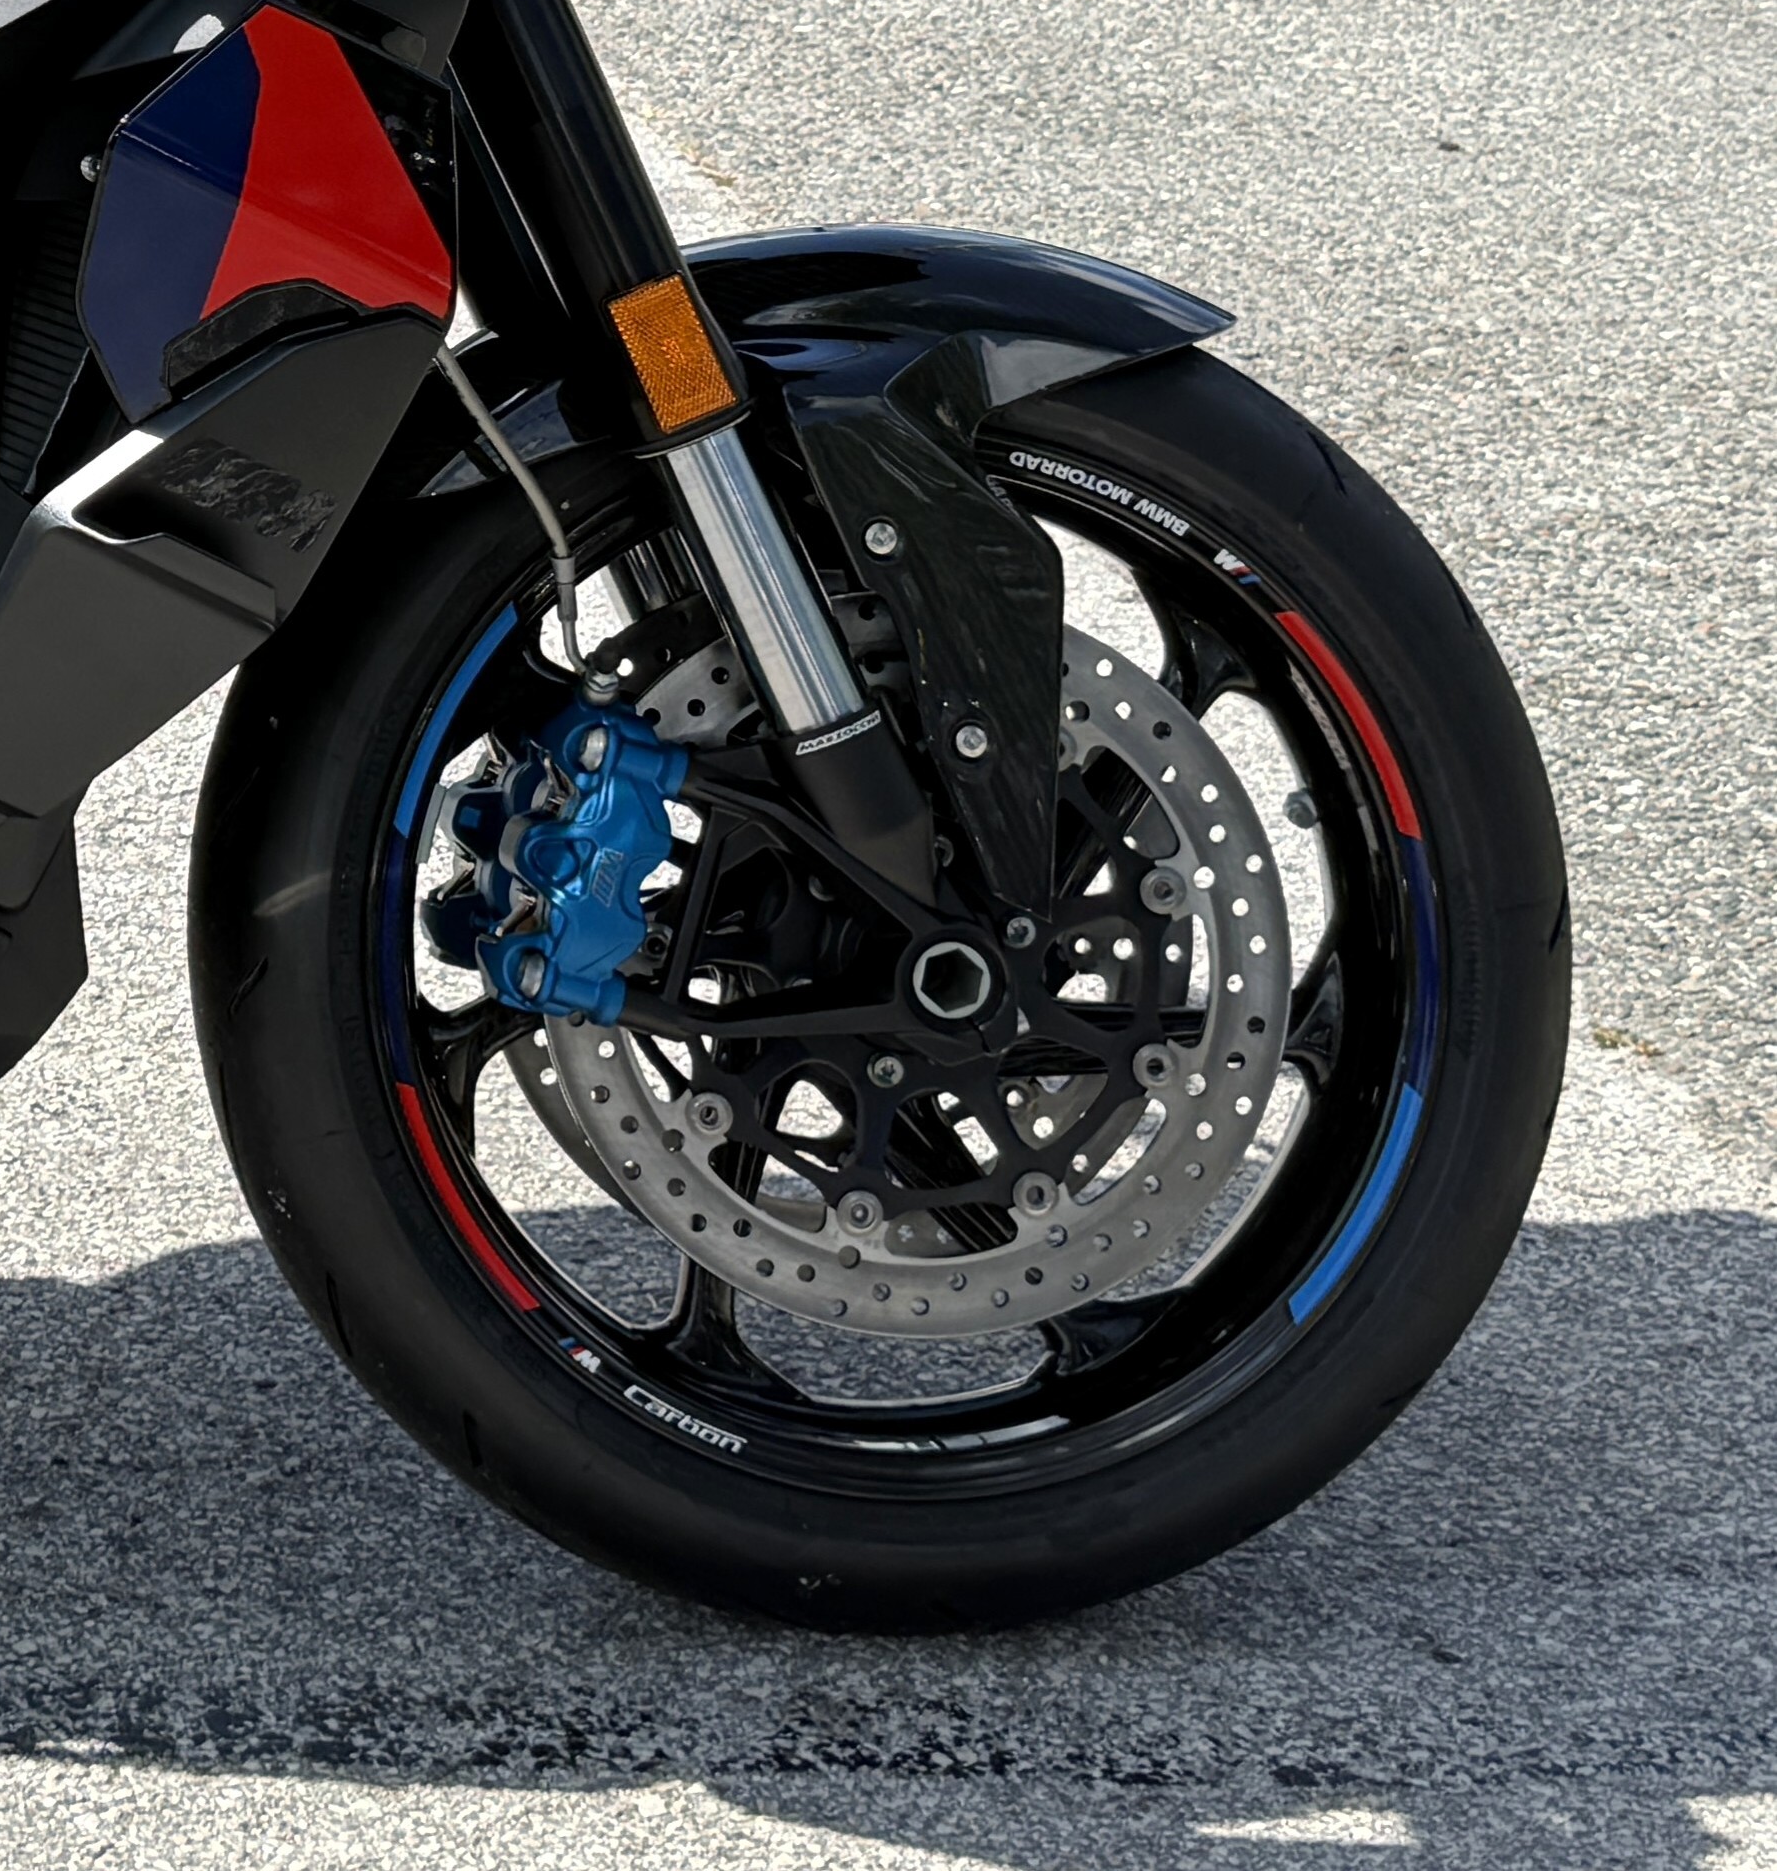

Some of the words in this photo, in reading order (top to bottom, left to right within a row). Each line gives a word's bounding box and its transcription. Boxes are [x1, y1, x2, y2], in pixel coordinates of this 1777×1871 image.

[1008, 451, 1134, 504] MOTORRAD
[1133, 498, 1191, 537] BMW
[623, 1384, 749, 1453] Carbon
